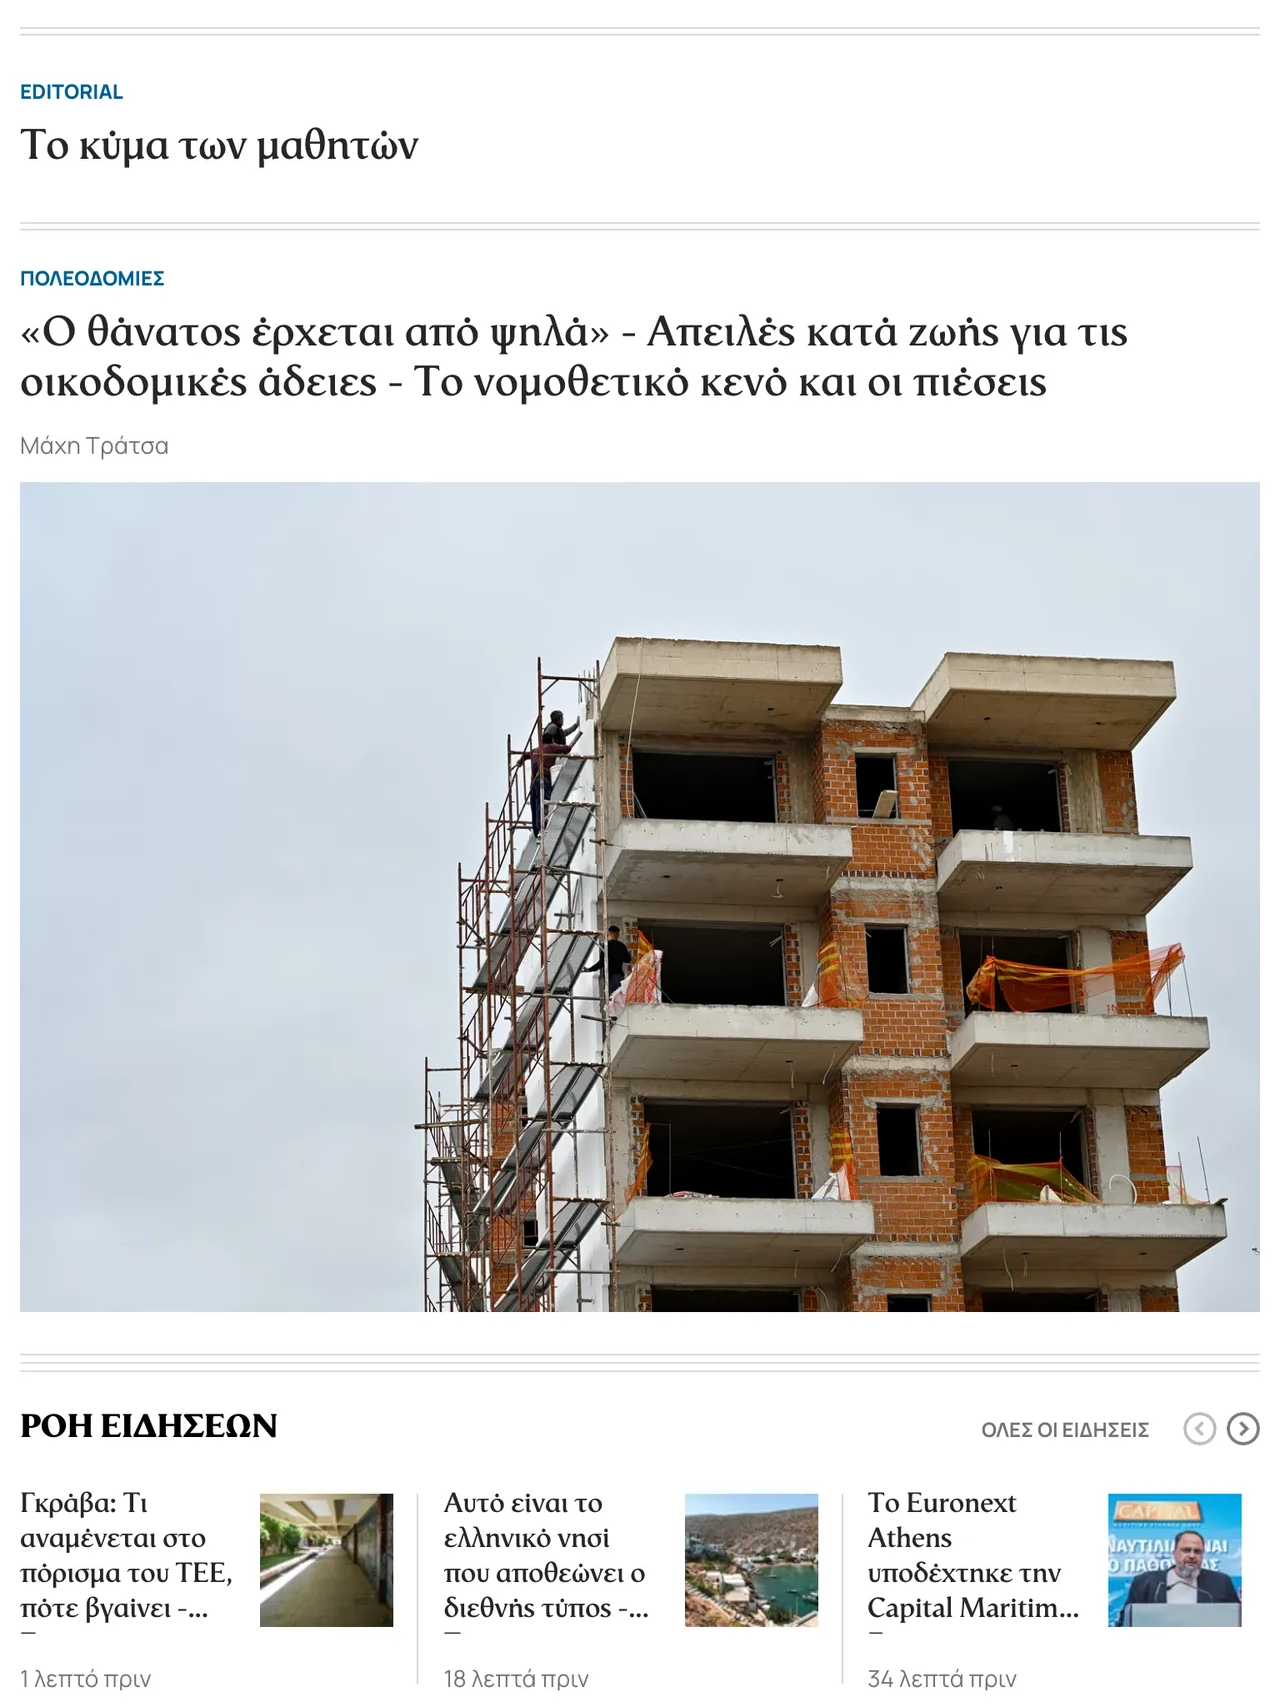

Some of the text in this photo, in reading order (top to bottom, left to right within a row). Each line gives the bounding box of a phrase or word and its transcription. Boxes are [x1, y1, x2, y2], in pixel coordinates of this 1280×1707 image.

[21, 84, 123, 99] EDITORIAL
[20, 127, 419, 168] Το κύμα των μαθητών
[21, 270, 164, 286] ΠΟΛΕΟΔΟΜΙΕΣ
[22, 315, 75, 346] «Ο
[88, 314, 240, 346] θάνατος
[253, 317, 394, 355] έρχεται
[406, 317, 478, 346] από
[491, 314, 608, 355] ψηλά»
[647, 314, 795, 346] Απειλές
[808, 317, 898, 346] κατά
[909, 317, 998, 346] ζωής
[1010, 324, 1067, 355] για
[1078, 324, 1127, 346] τις
[21, 364, 247, 405] οικοδομικές
[259, 364, 376, 396] άδειες
[414, 365, 462, 396] Το
[474, 364, 688, 405] νομοθετικό
[701, 367, 787, 396] κενό
[800, 375, 856, 396] και
[868, 375, 902, 396] οι
[913, 367, 1046, 396] πιέσεις
[22, 435, 168, 460] Μάχη Τράτσα
[21, 1414, 277, 1438] ΡΟΗ ΕΙΔΗΣΕΩΝ
[982, 1422, 1149, 1437] ΟΛΕΣ ΟΙ ΕΙΔΗΣΕΙΣ
[21, 1491, 147, 1518] Γκράβα: Τι
[444, 1492, 602, 1513] Αυτό είναι το
[868, 1492, 1017, 1513] Το Euronext
[1118, 1504, 1199, 1519] CAPITAL
[21, 1528, 206, 1553] αναμένεται στο
[445, 1526, 609, 1548] ελληνικό νησί
[868, 1526, 952, 1547] Athens
[1108, 1539, 1175, 1553] ΝΑΥΤΙΛΙ
[20, 1562, 232, 1588] πόρισμα του ΤΕΕ,
[444, 1561, 645, 1582] που αποθεώνει ο
[868, 1561, 1061, 1583] υποδέχτηκε την
[20, 1598, 78, 1618] πότε
[87, 1596, 171, 1623] βγαίνει
[445, 1596, 534, 1618] διεθνής
[541, 1598, 611, 1618] τύπος
[868, 1596, 952, 1623] Capital
[21, 1669, 151, 1690] 1 λεπτό πριν
[445, 1669, 588, 1690] 18 λεπτά πριν
